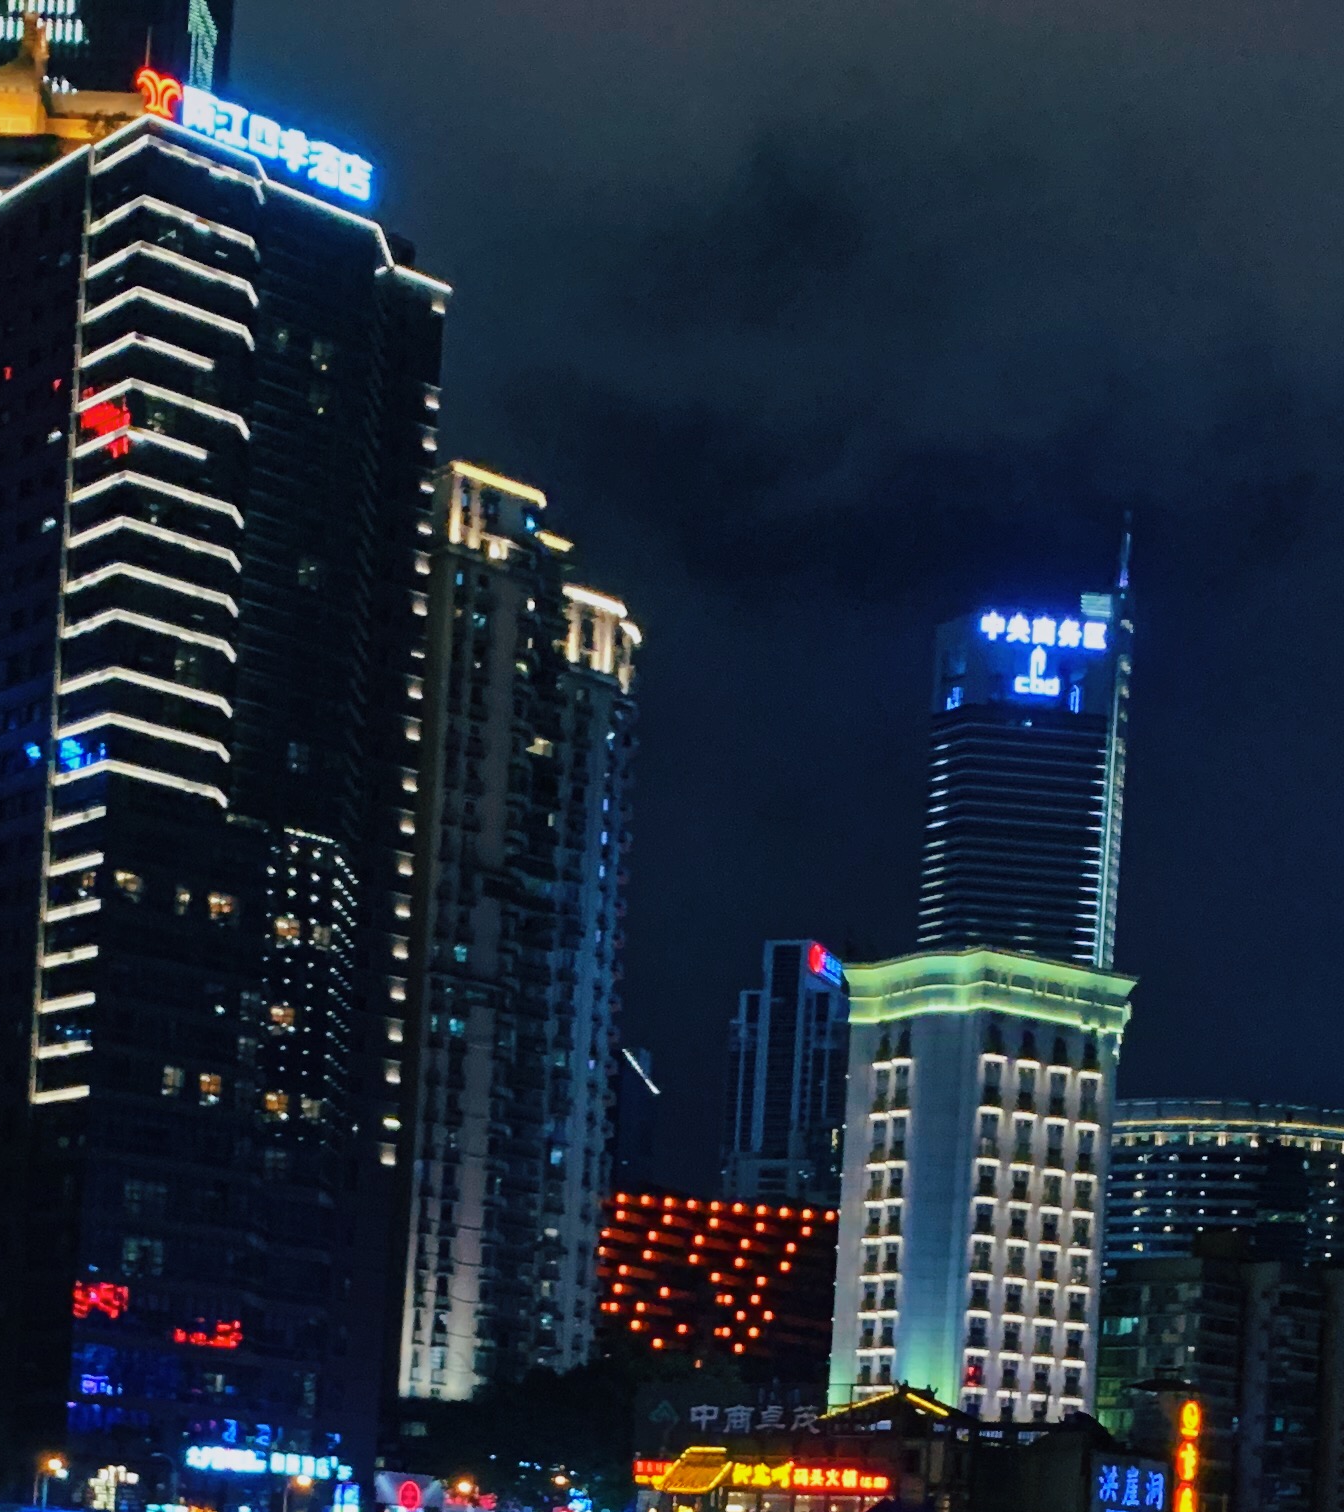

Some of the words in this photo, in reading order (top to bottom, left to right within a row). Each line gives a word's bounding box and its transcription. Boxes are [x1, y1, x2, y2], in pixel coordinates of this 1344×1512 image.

[980, 609, 1108, 651] 中央商务区
[1098, 1464, 1164, 1511] 洪崖洞
